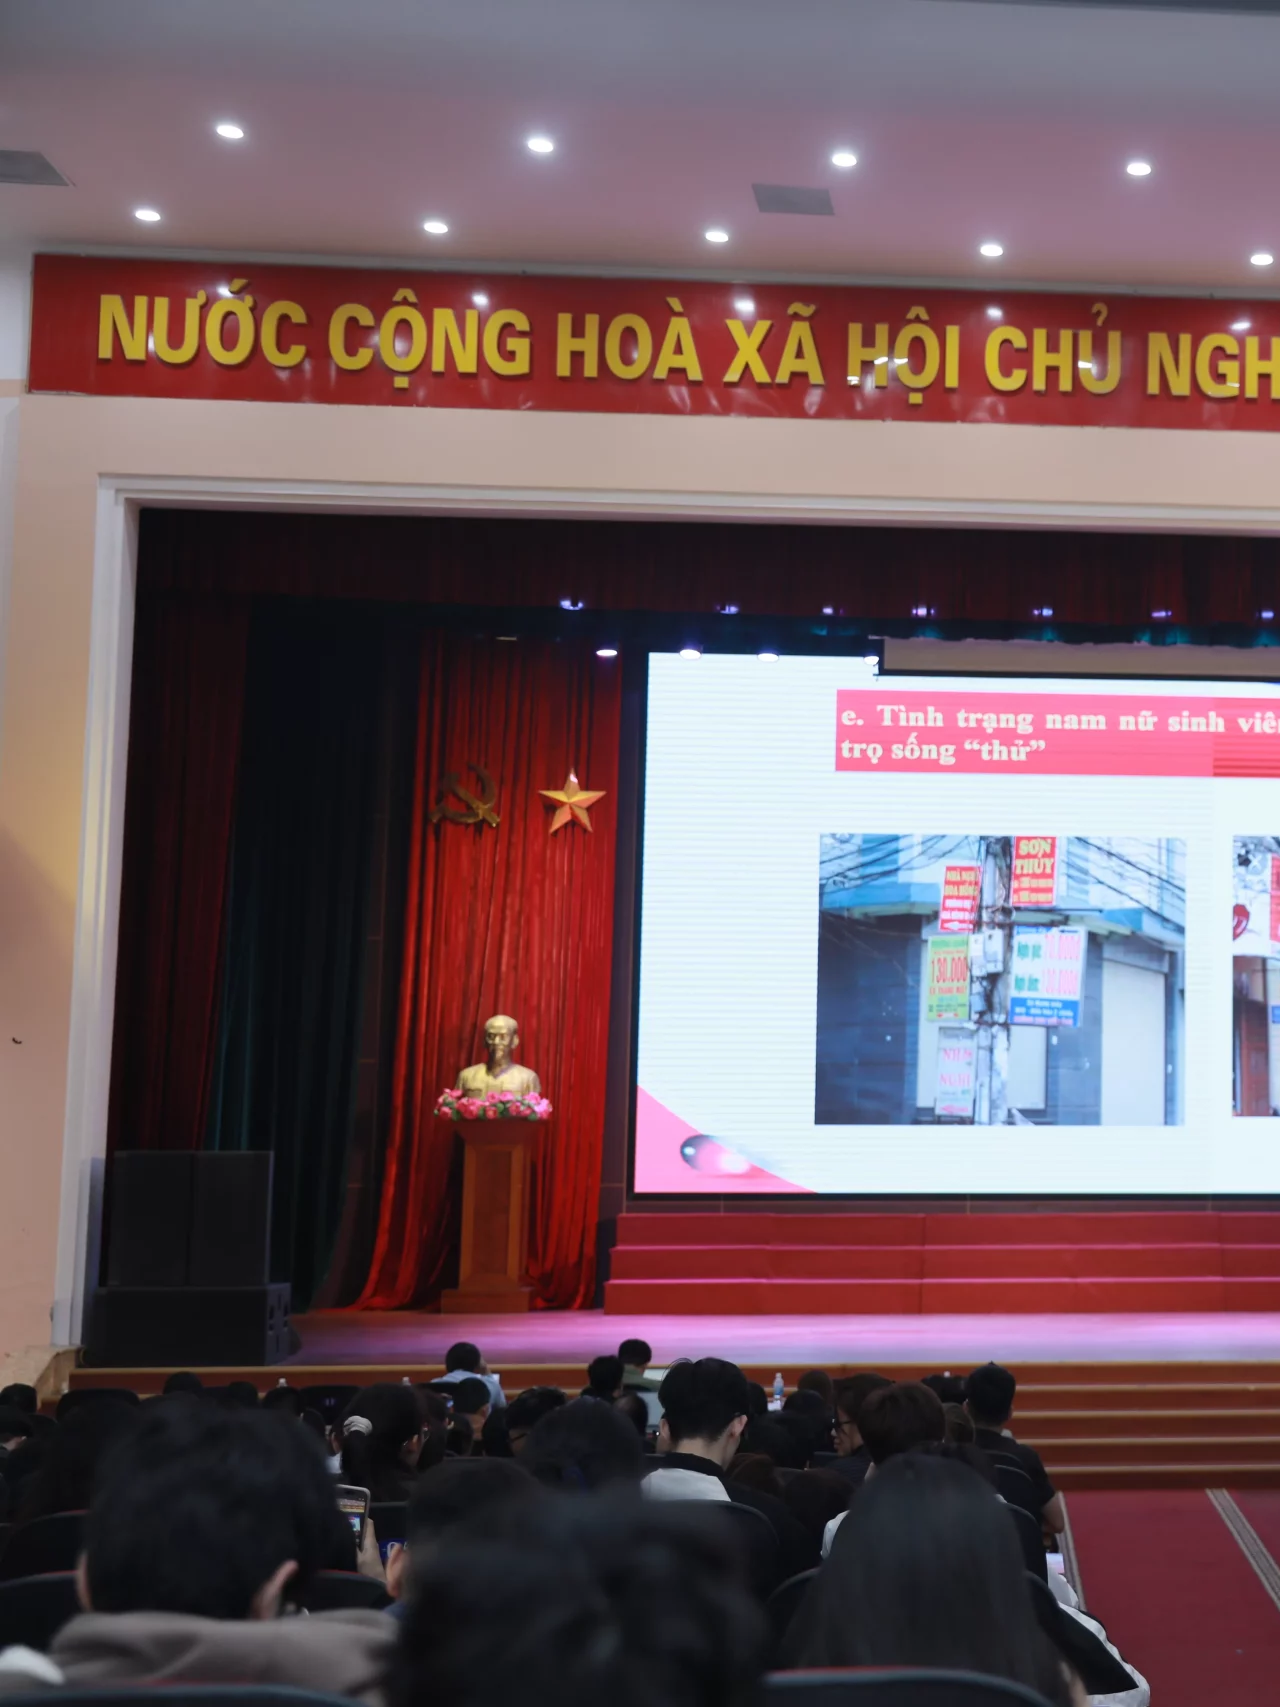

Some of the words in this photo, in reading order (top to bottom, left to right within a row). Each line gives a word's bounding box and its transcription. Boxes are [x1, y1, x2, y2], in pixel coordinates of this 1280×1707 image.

[98, 278, 307, 369] NƯỚC
[329, 288, 531, 388] CỘNG
[555, 298, 703, 382] HOÀ
[723, 302, 825, 386] XÃ
[847, 306, 960, 405] HỘI
[984, 303, 1122, 395] CHỦ
[841, 709, 864, 727] e.
[877, 705, 944, 727] Tình
[957, 708, 1034, 734] trạng
[1045, 713, 1107, 730] nam
[1118, 708, 1158, 731] nữ
[1168, 711, 1225, 733] sinh
[841, 739, 883, 764] trọ
[891, 732, 956, 766] sống
